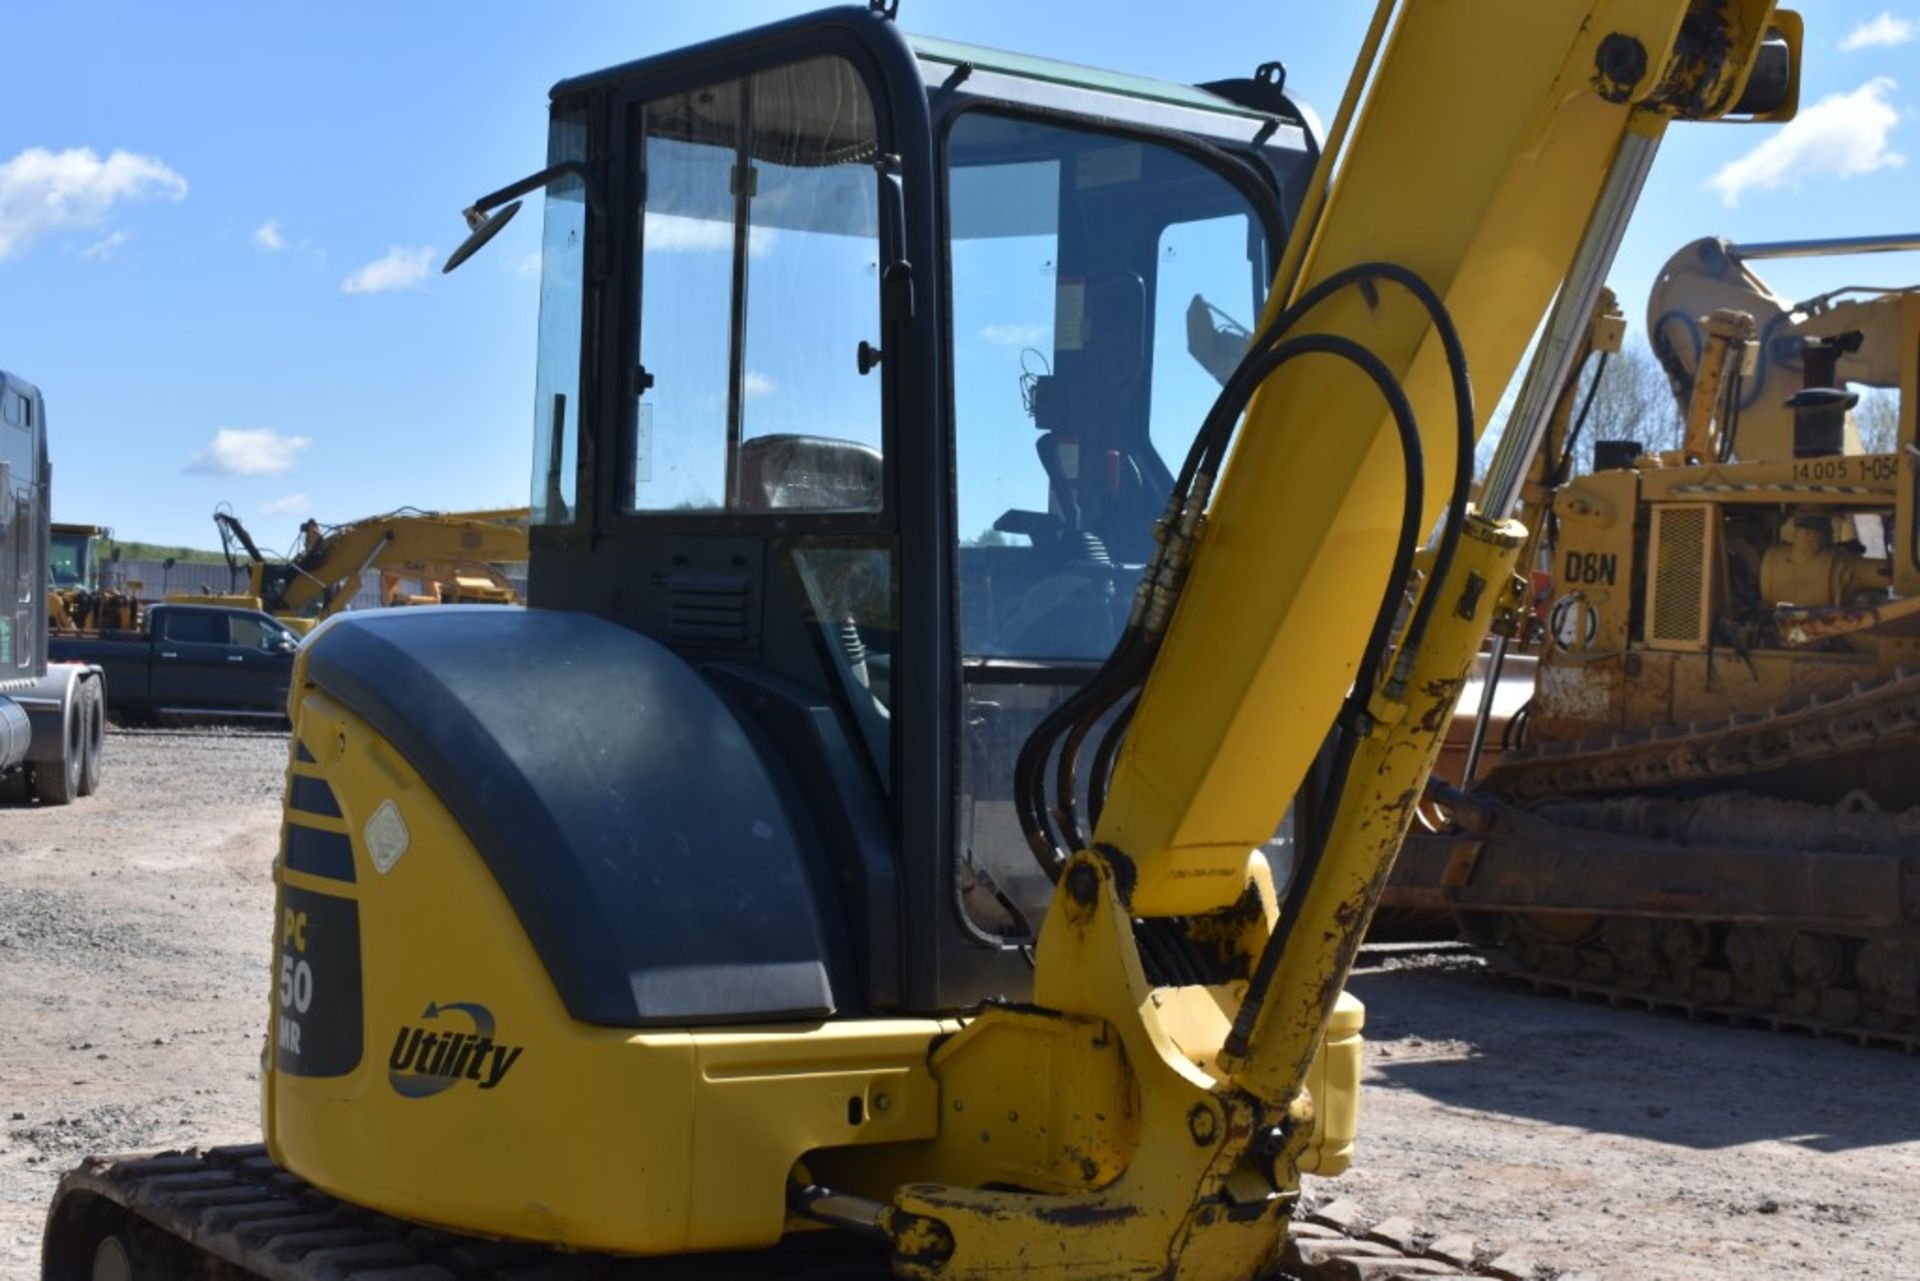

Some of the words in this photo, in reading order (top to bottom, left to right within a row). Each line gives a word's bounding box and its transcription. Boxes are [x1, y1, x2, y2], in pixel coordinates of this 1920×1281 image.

[1565, 551, 1617, 587] D8N
[283, 906, 307, 953] PC
[280, 953, 312, 1014] 50
[389, 1026, 524, 1089] Utility
